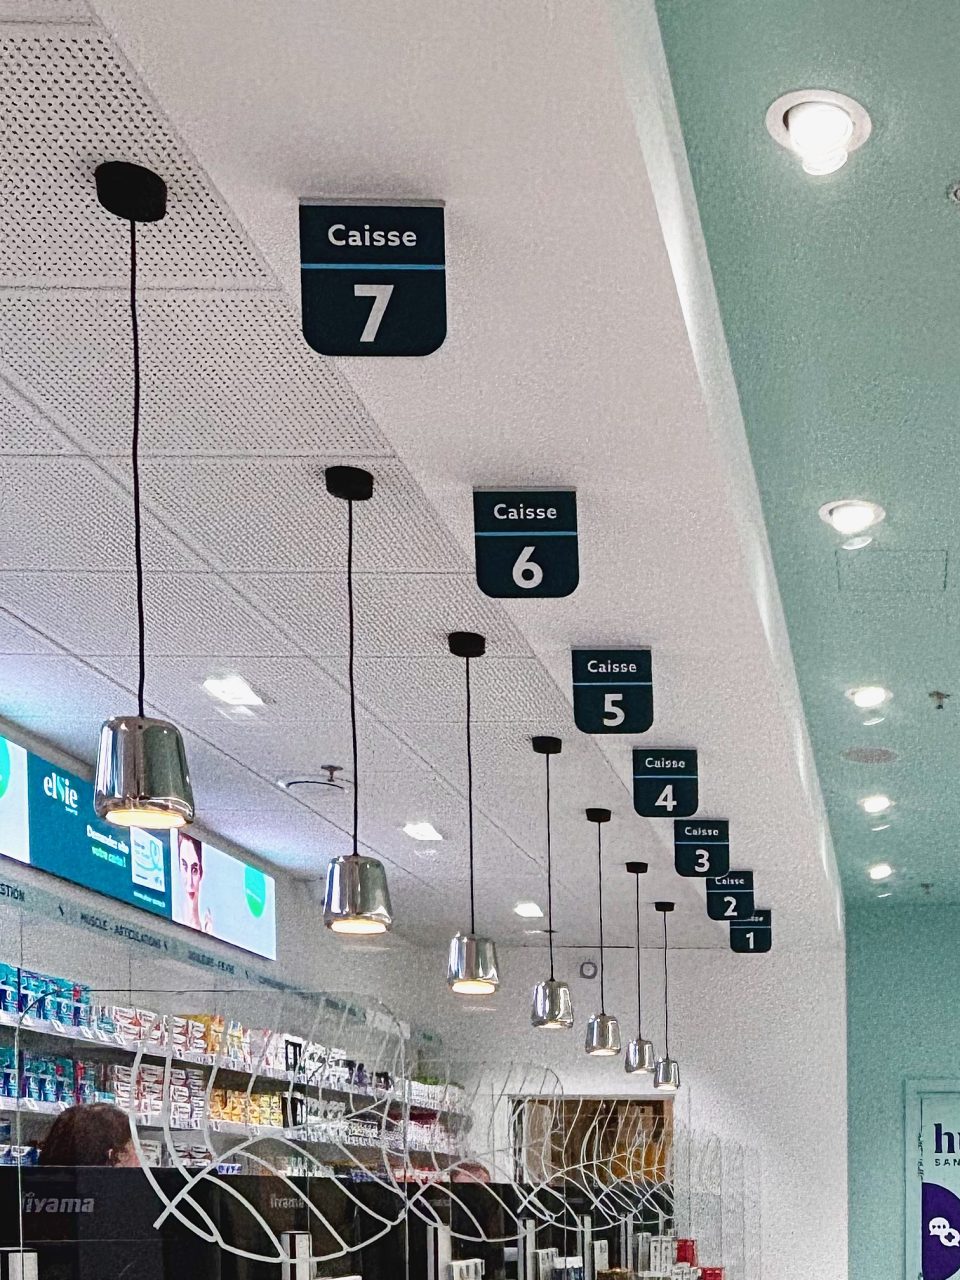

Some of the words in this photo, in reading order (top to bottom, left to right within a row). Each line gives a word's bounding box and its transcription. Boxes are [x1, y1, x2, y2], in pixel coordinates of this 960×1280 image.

[327, 223, 418, 248] Caisse
[353, 284, 394, 343] 7
[493, 503, 558, 521] Caisse
[511, 546, 544, 589] 6
[586, 659, 638, 674] Caisse
[602, 693, 626, 728] 5
[645, 757, 686, 769] Caisse
[654, 784, 678, 812] 4
[684, 826, 719, 837] Caisse
[694, 849, 710, 873] 3
[723, 896, 738, 917] 2
[745, 931, 755, 950] 1
